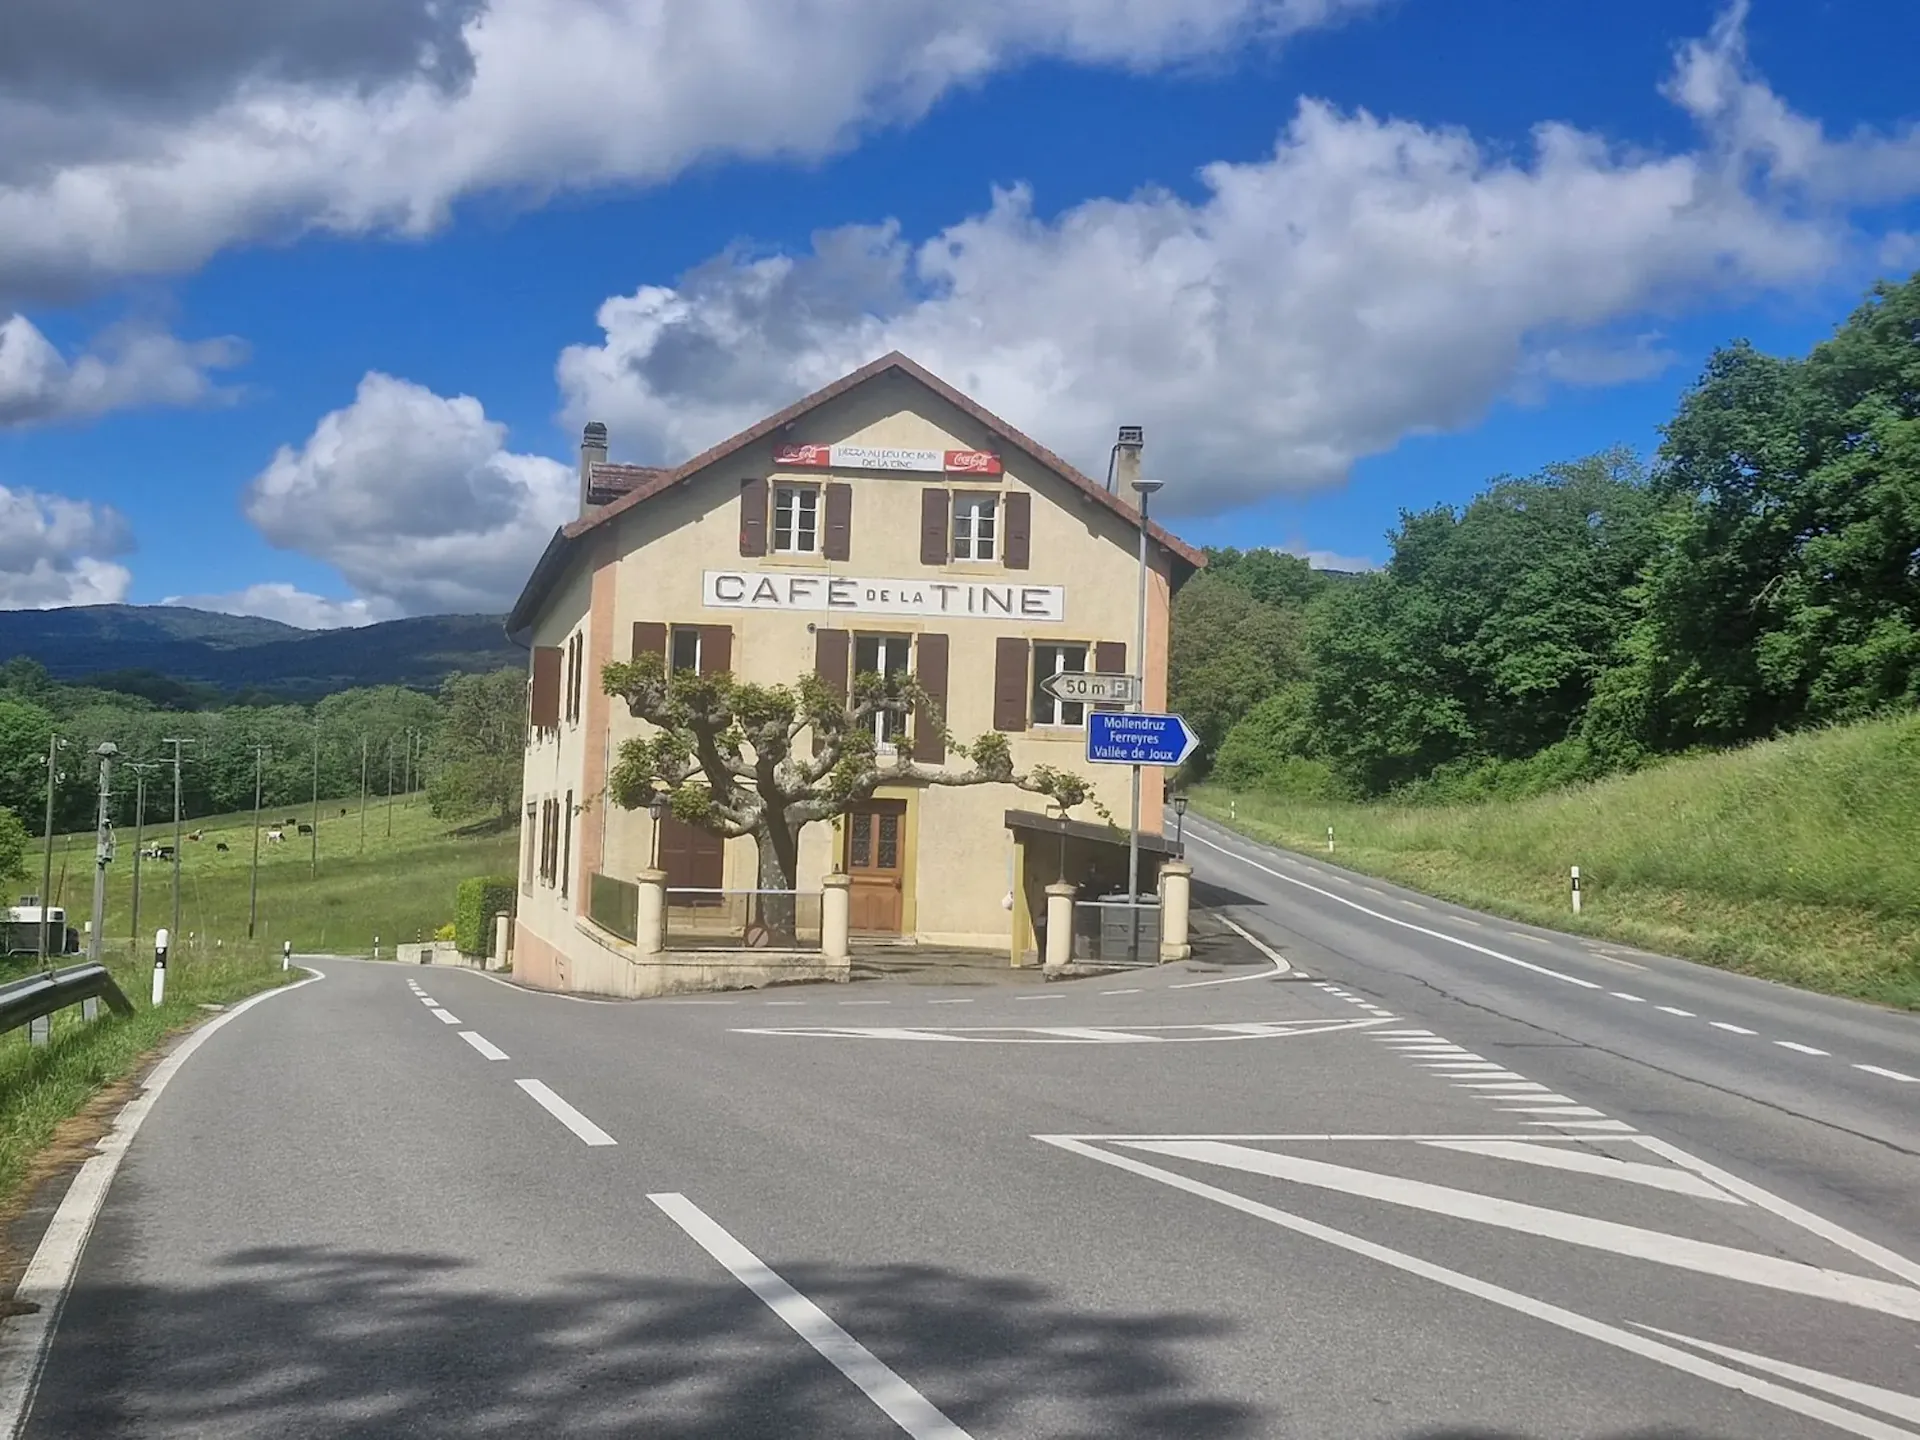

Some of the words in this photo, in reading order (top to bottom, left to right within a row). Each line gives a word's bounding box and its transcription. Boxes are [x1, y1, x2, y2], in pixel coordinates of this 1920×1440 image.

[866, 588, 890, 602] DE
[901, 591, 924, 604] LA
[930, 584, 1051, 616] TINE
[1066, 679, 1087, 694] 50
[1091, 683, 1105, 695] m
[1114, 682, 1125, 696] P
[1104, 717, 1166, 731] Mollendruz
[1109, 730, 1159, 746] Ferreyres
[1094, 745, 1127, 758] Vallée
[1131, 747, 1145, 759] de
[1149, 748, 1173, 761] Joux
